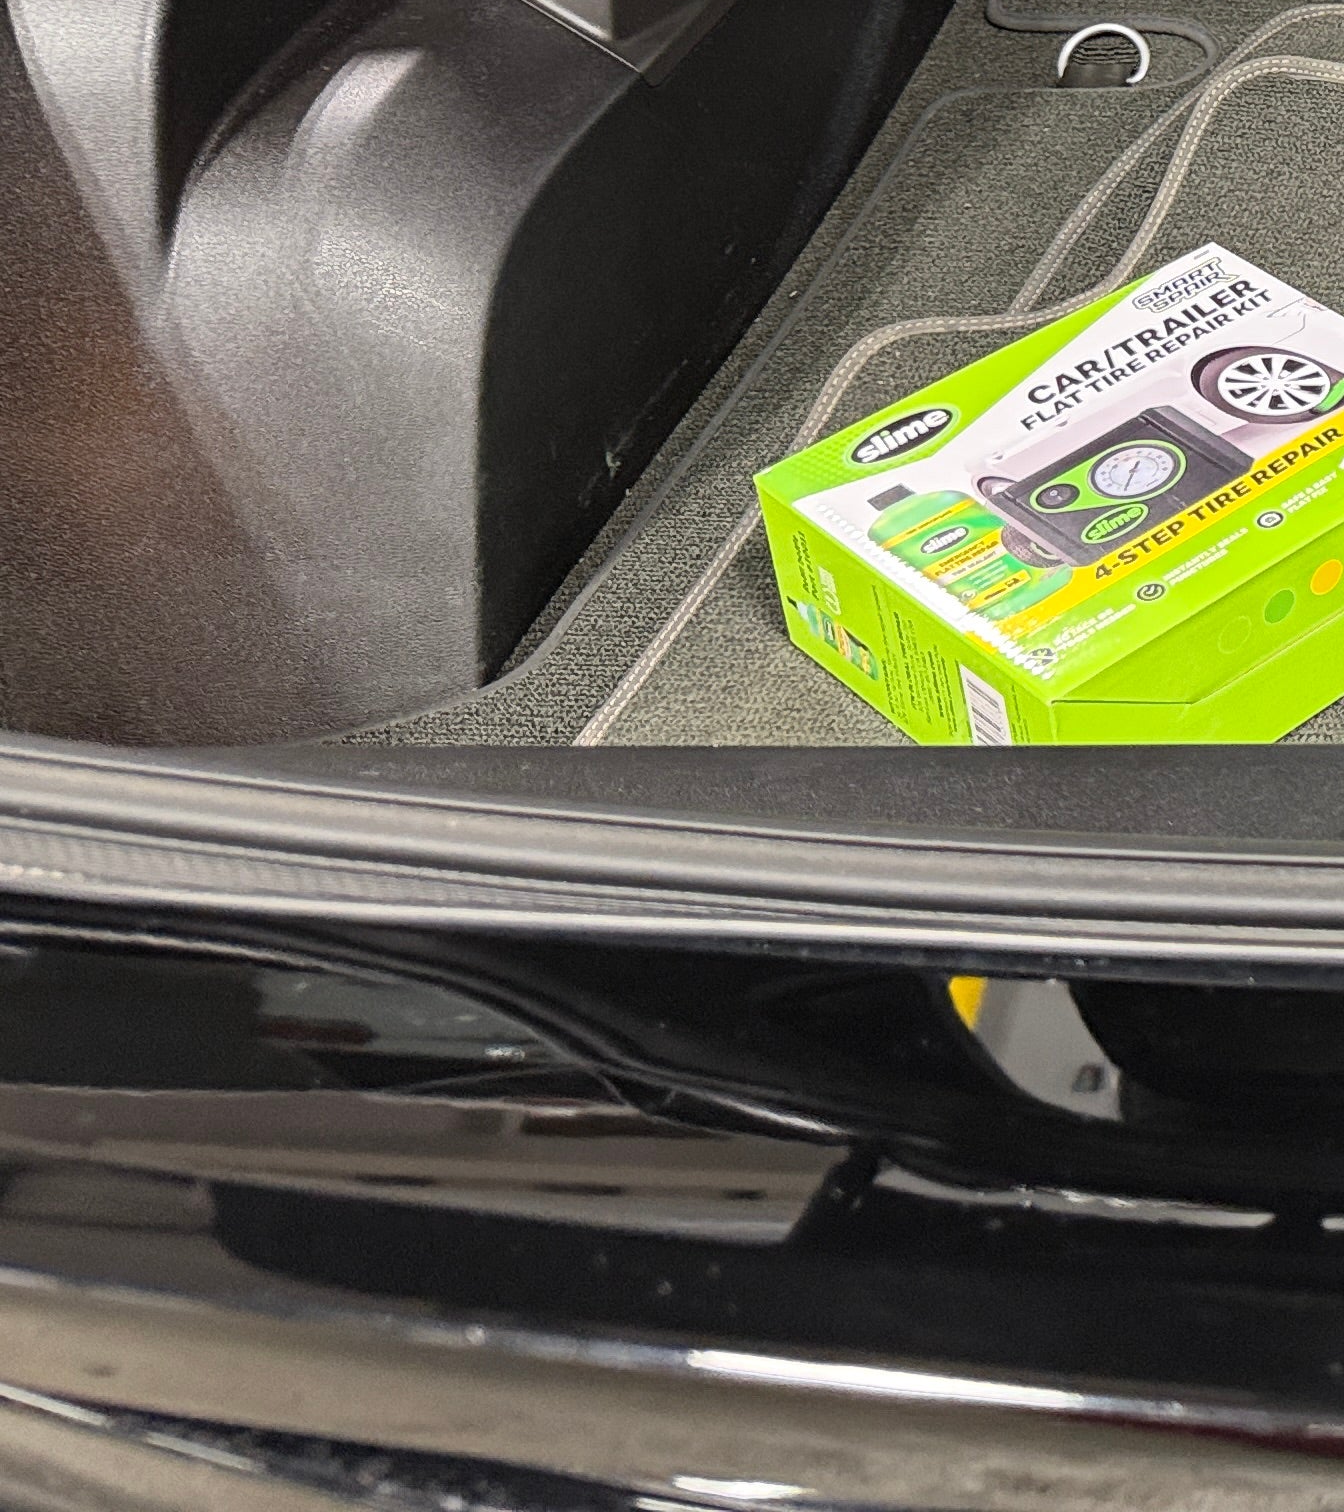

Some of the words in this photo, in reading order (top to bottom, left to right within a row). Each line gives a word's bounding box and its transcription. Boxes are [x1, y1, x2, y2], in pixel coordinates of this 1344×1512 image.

[1137, 263, 1218, 308] SMART
[1153, 271, 1231, 311] SPAIR
[1020, 388, 1084, 431] FLAT
[1085, 357, 1147, 393] TIRE
[1145, 314, 1234, 363] REPAIR
[1232, 288, 1272, 318] KIT
[1027, 279, 1260, 405] CAR/TRAILER
[856, 410, 950, 463] slime
[1087, 506, 1142, 540] slime
[1095, 520, 1186, 580] 4-STEP
[1187, 481, 1252, 524] TIRE
[1250, 426, 1344, 486] REPAIR
[923, 527, 967, 554] slime
